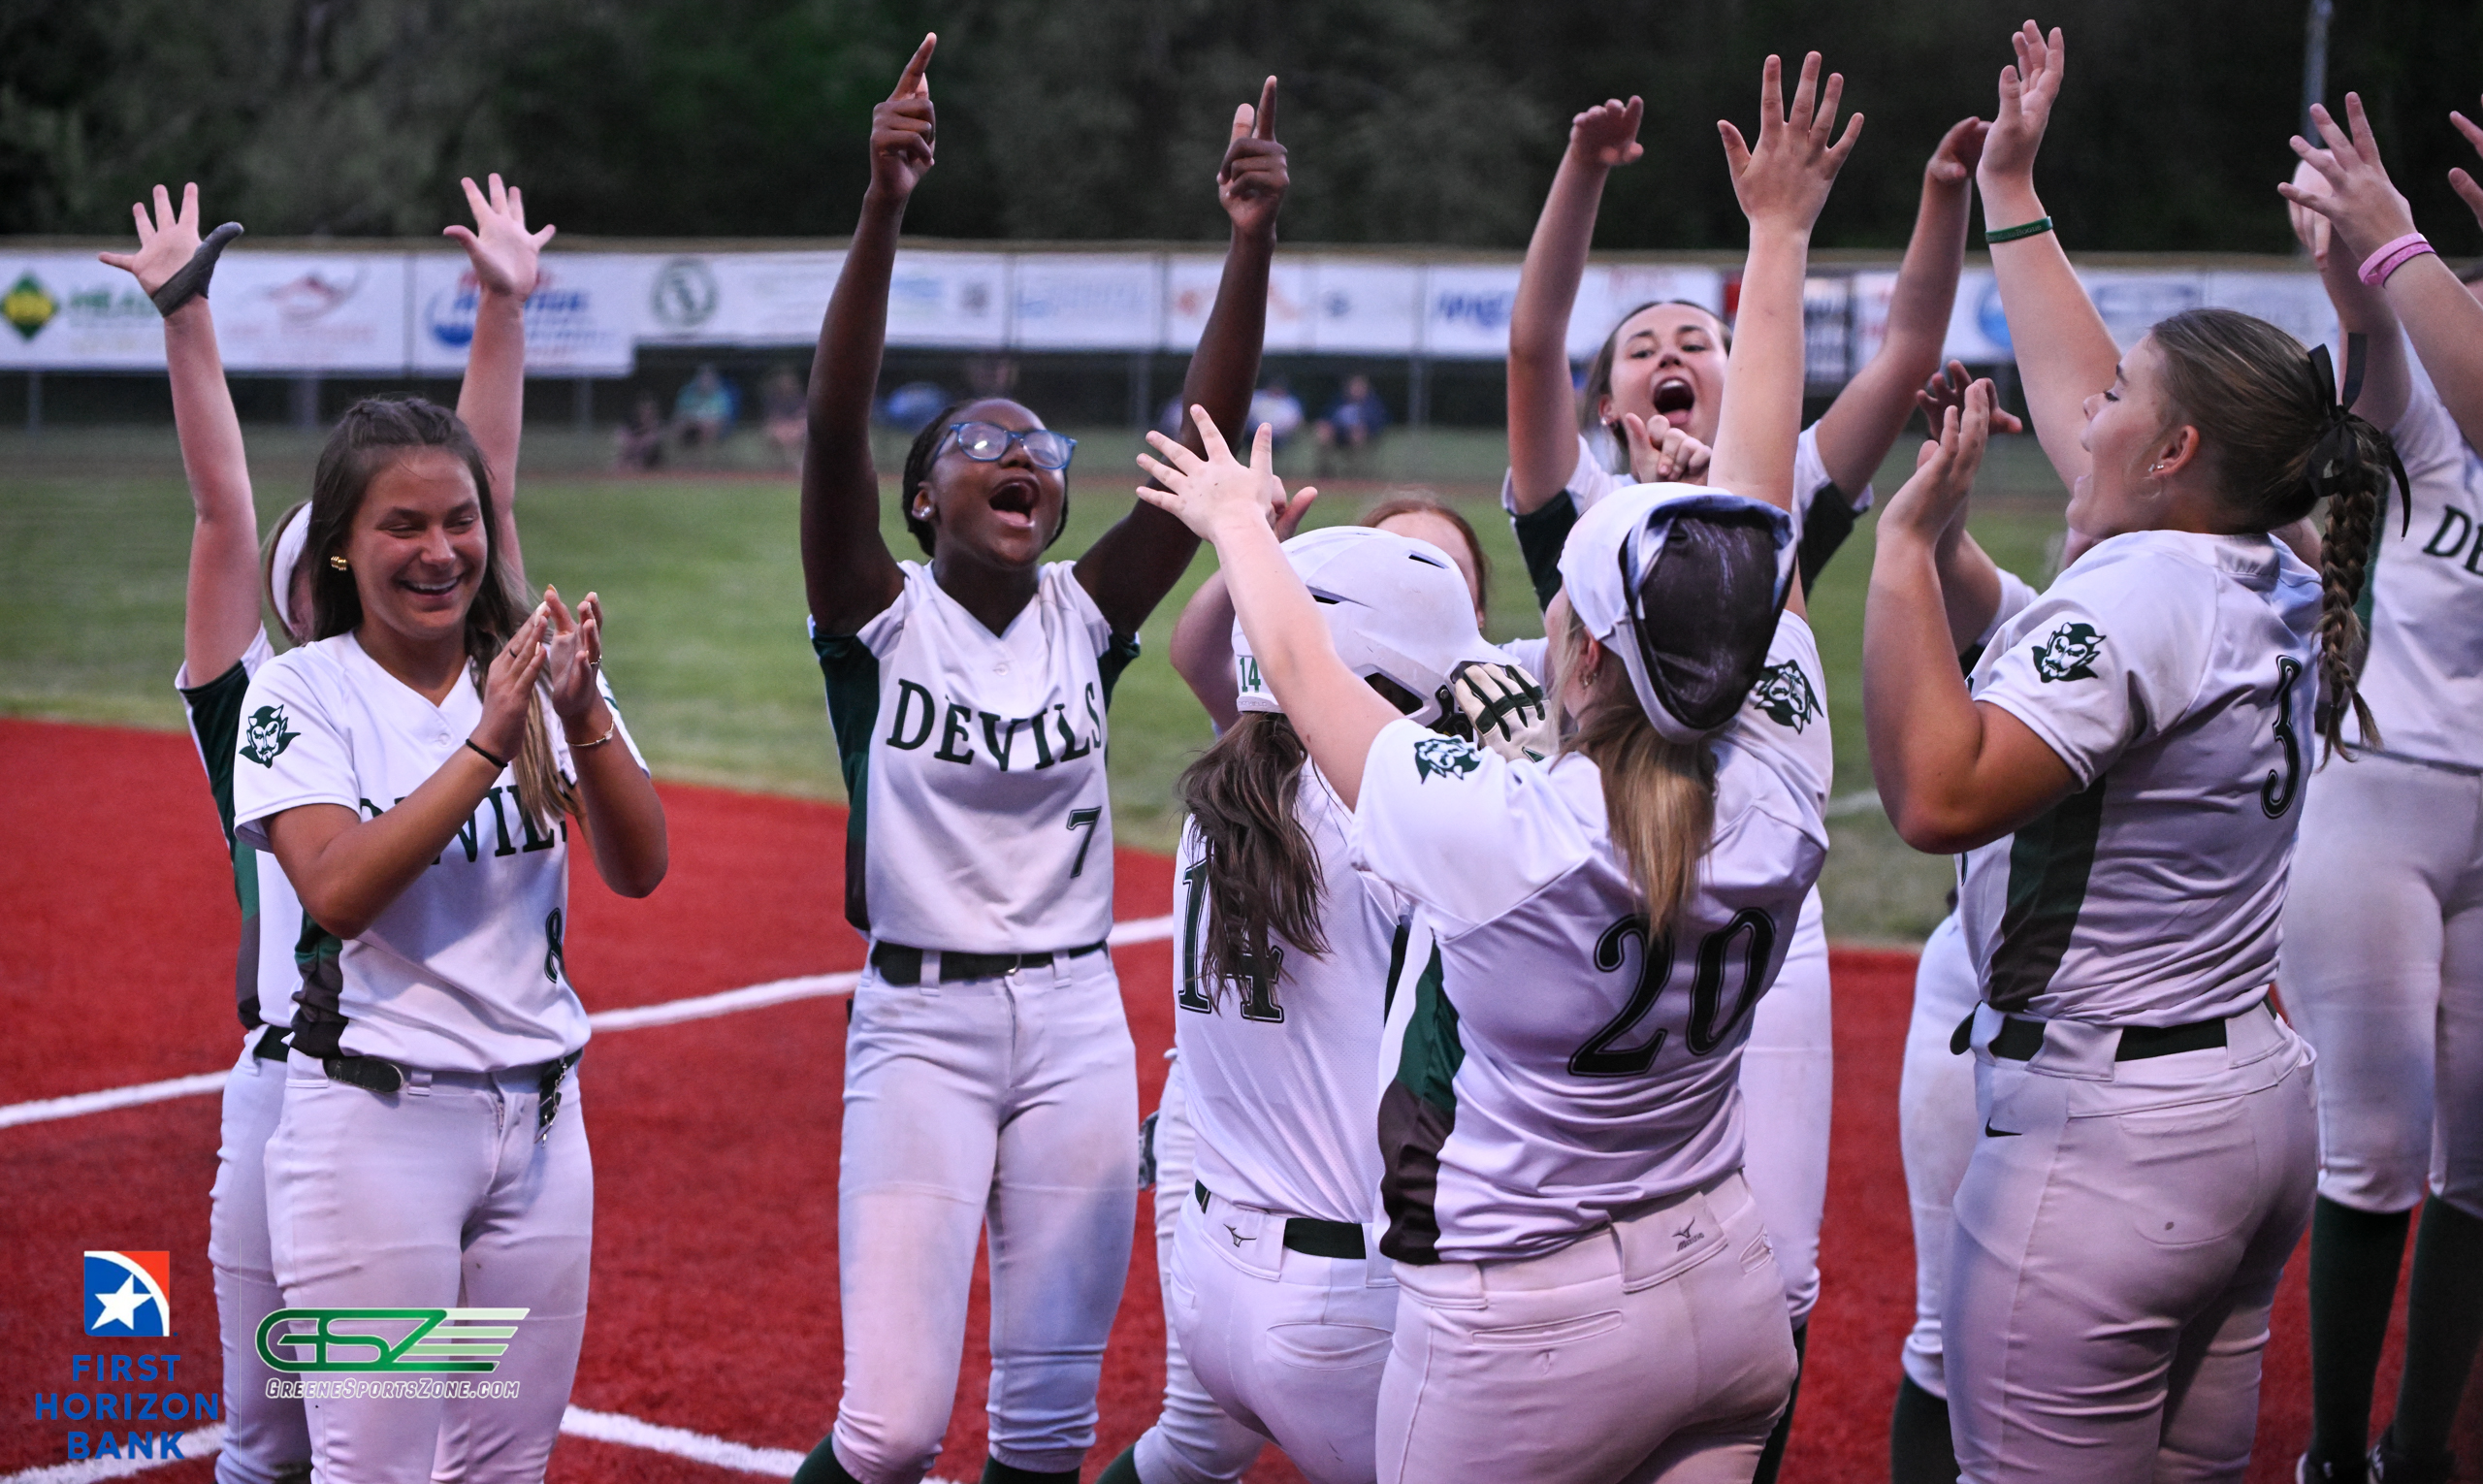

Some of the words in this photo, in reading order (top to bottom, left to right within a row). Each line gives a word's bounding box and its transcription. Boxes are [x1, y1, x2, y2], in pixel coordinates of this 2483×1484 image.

[1239, 657, 1262, 693] 14
[886, 677, 1103, 772] DEVILS
[1066, 805, 1103, 879] 7
[543, 907, 564, 984] 8
[1177, 857, 1285, 1023] 14
[1567, 906, 1777, 1078] 20
